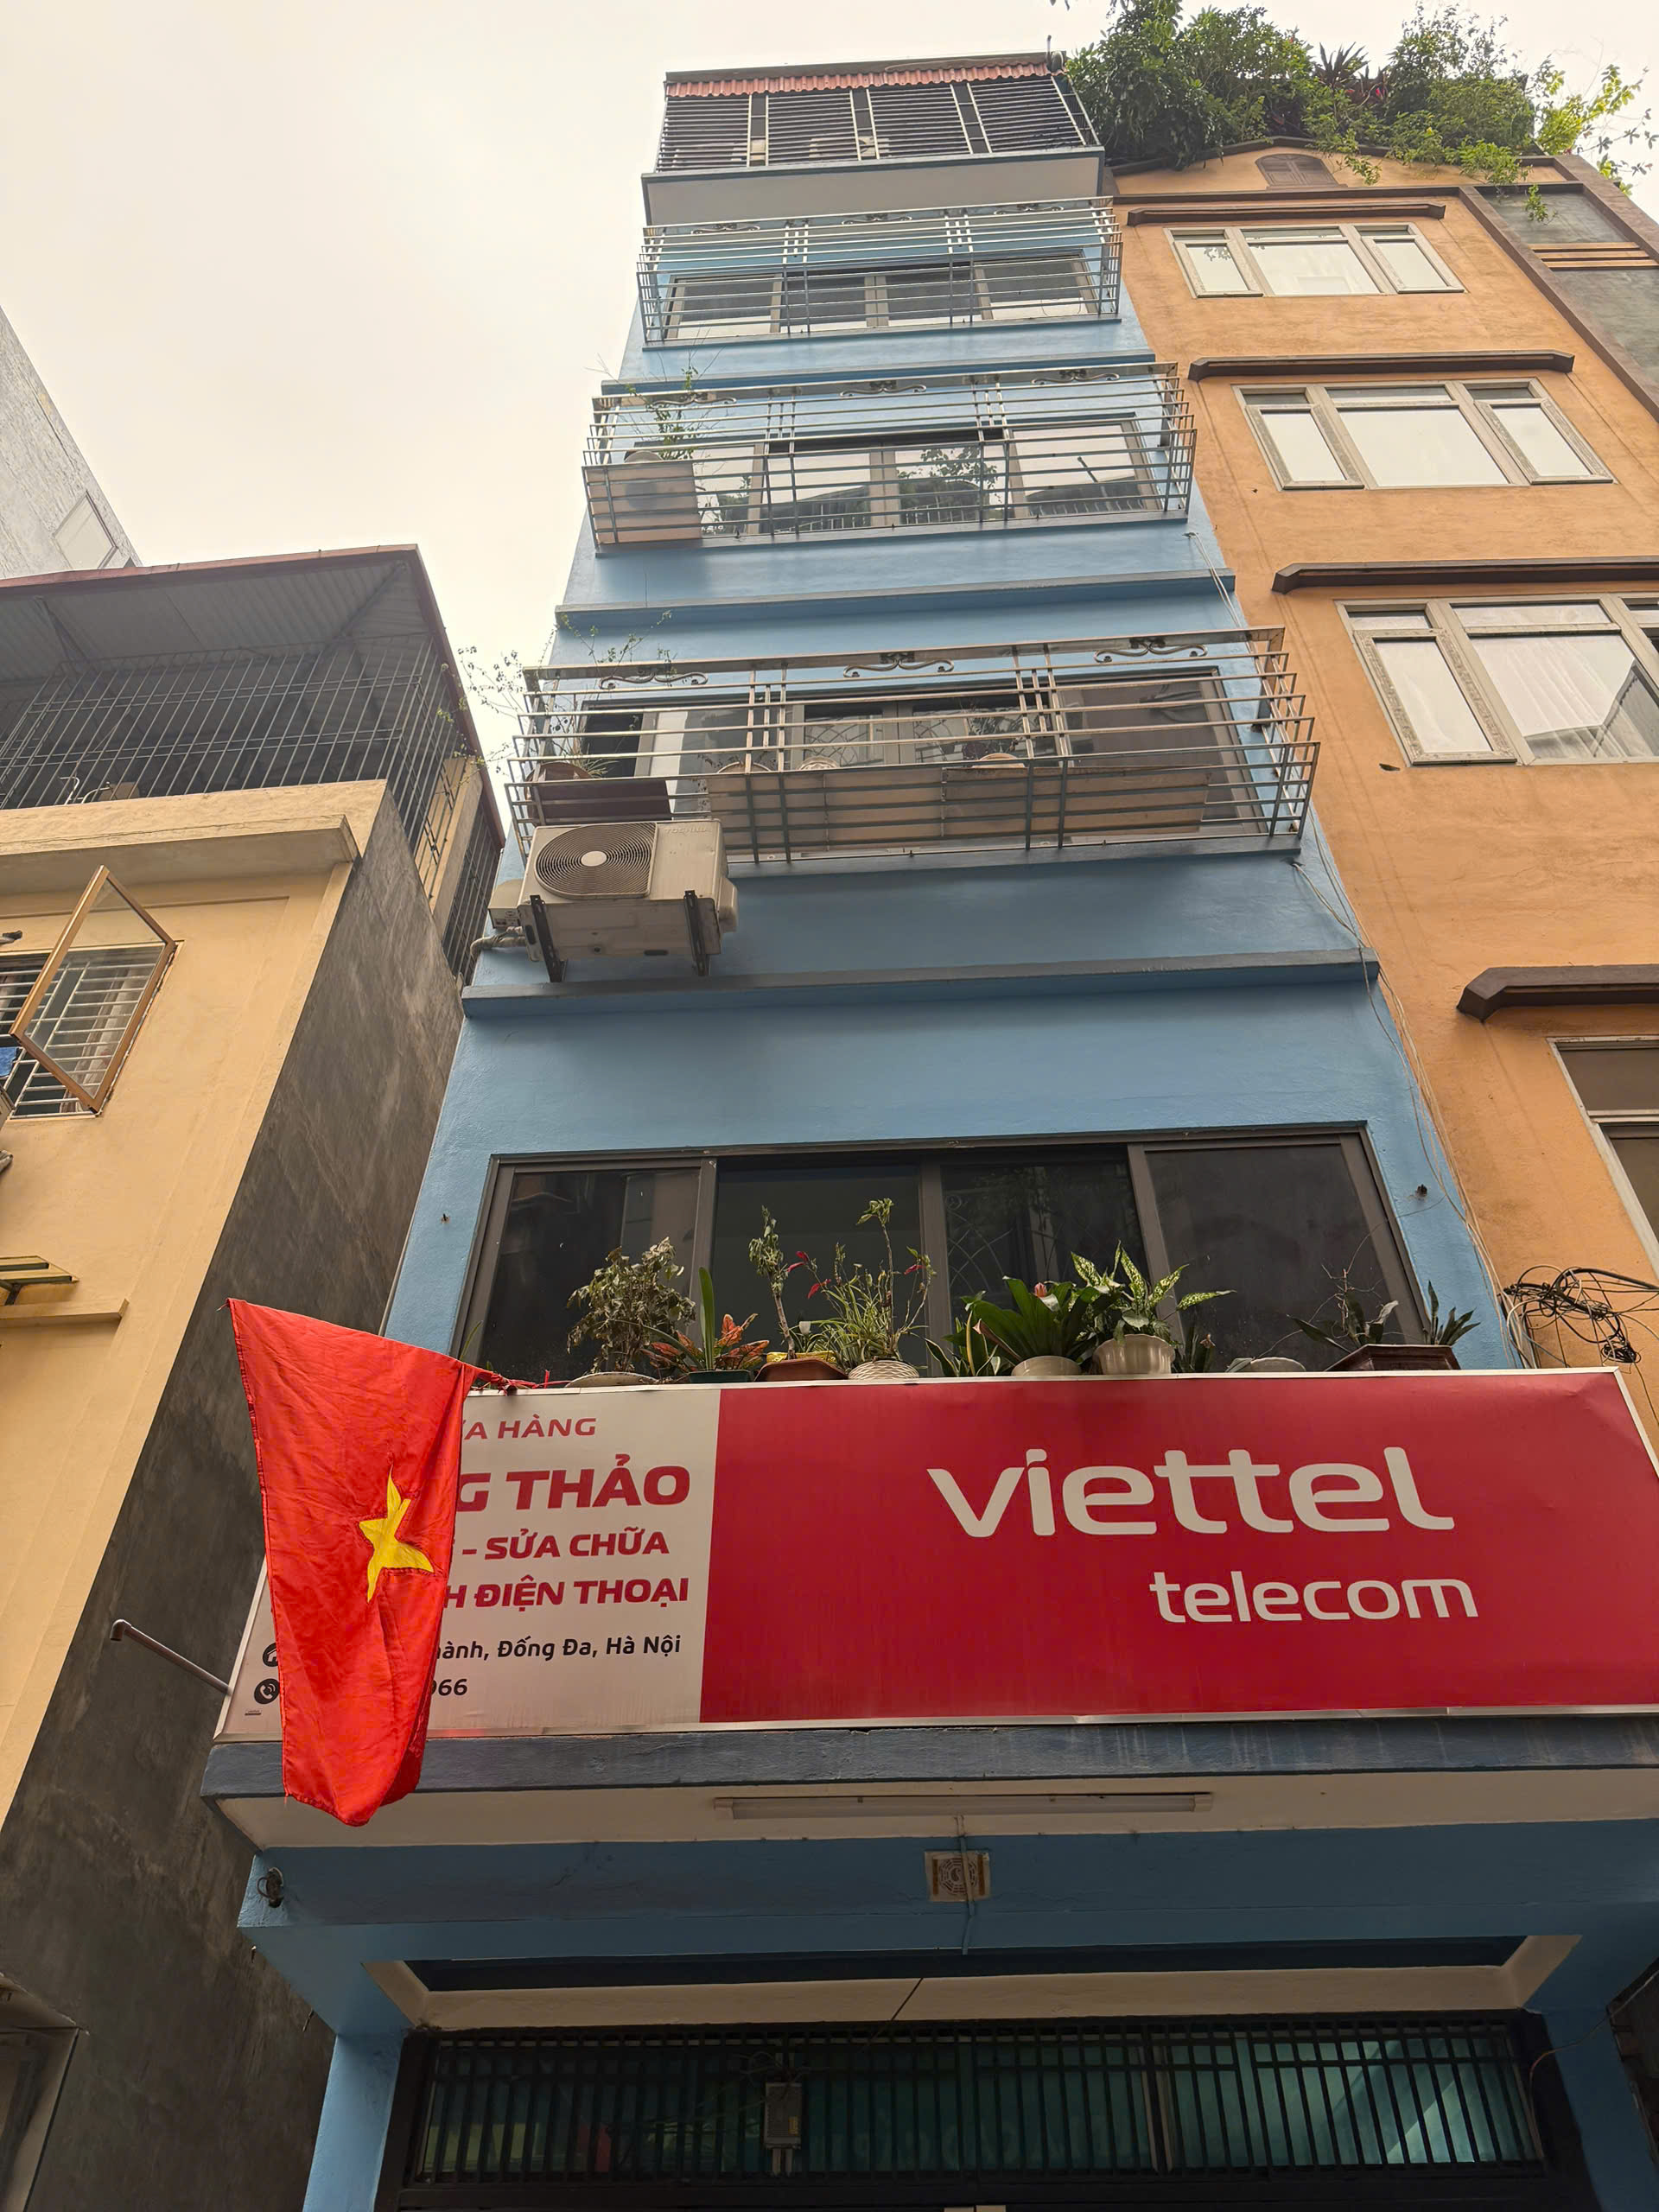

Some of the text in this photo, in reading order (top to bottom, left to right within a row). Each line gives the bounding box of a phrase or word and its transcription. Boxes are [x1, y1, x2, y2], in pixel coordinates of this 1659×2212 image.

[497, 1414, 596, 1440] HÀNG
[505, 1453, 690, 1510] THẢO
[926, 1446, 1455, 1538] viettel
[484, 1528, 561, 1560] SỬA
[569, 1526, 671, 1557] CHỮA
[474, 1573, 565, 1612] ĐIỆN
[573, 1577, 690, 1608] THOẠI
[1149, 1571, 1478, 1623] telecom
[436, 1634, 682, 1662] ành, Đống Đa, Hà Nội
